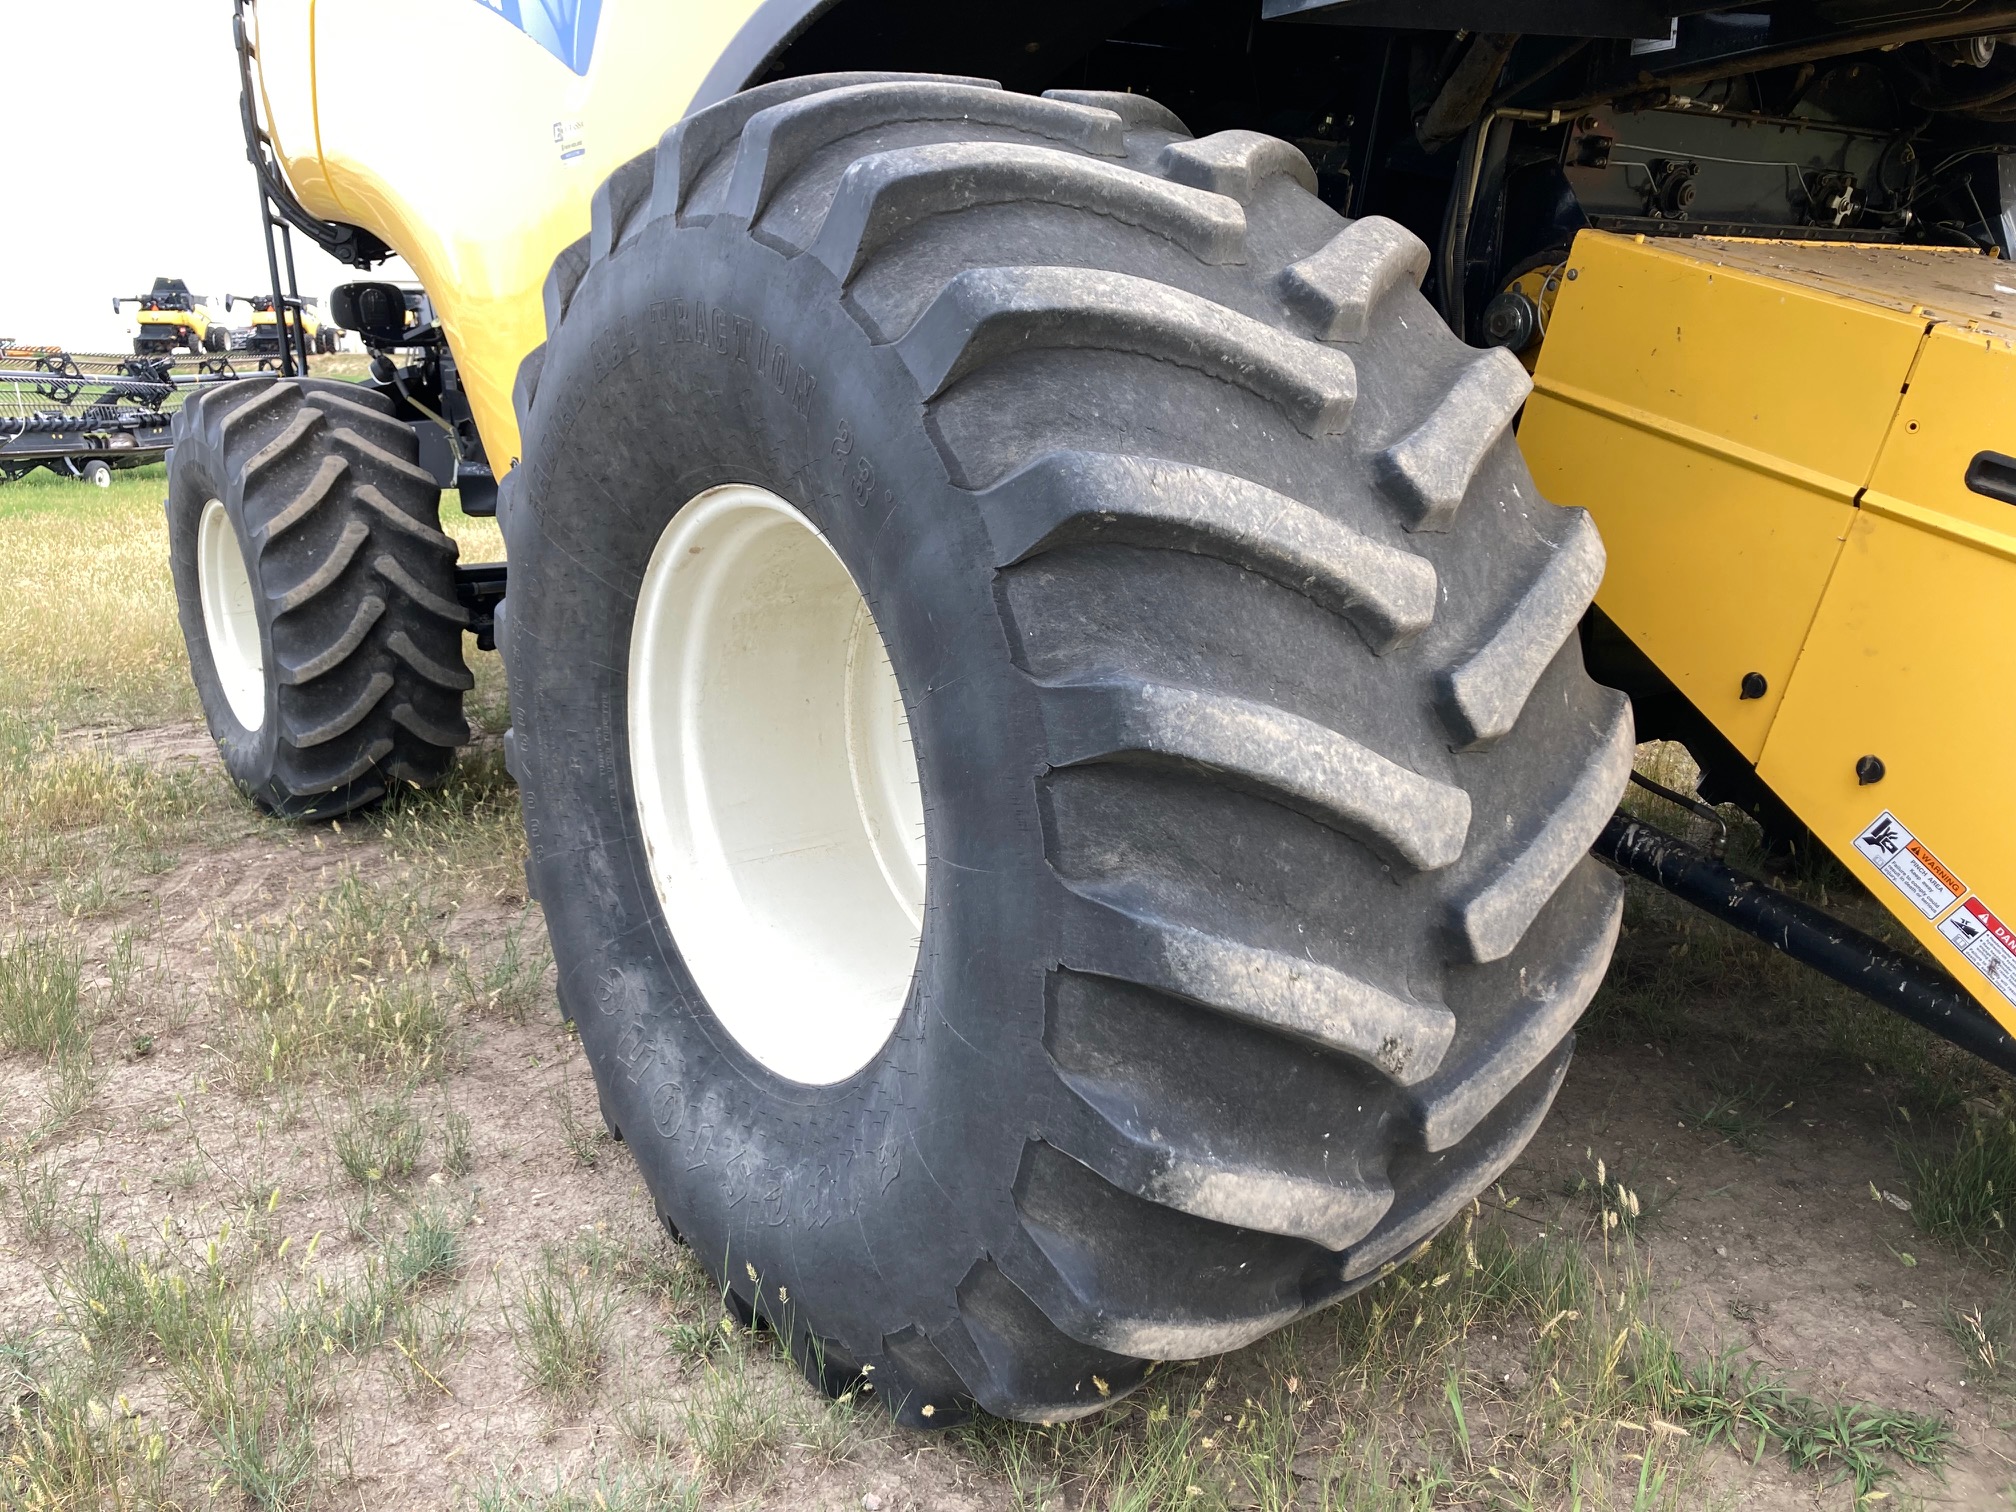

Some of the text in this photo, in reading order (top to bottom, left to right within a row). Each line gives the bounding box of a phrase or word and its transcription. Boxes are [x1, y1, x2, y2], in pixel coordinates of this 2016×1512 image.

[649, 297, 818, 423] TRACTION
[1887, 864, 1901, 877] result
[1904, 881, 1917, 893] death
[1920, 897, 1937, 914] serious
[1891, 860, 1907, 876] Failure
[1910, 880, 1927, 896] comply
[1926, 895, 1940, 909] could
[1909, 868, 1922, 881] Keep
[1921, 881, 1934, 893] away
[1910, 859, 1944, 893] PINCH AREA
[1921, 854, 1960, 892] WARNING
[1994, 927, 2016, 953] DAN
